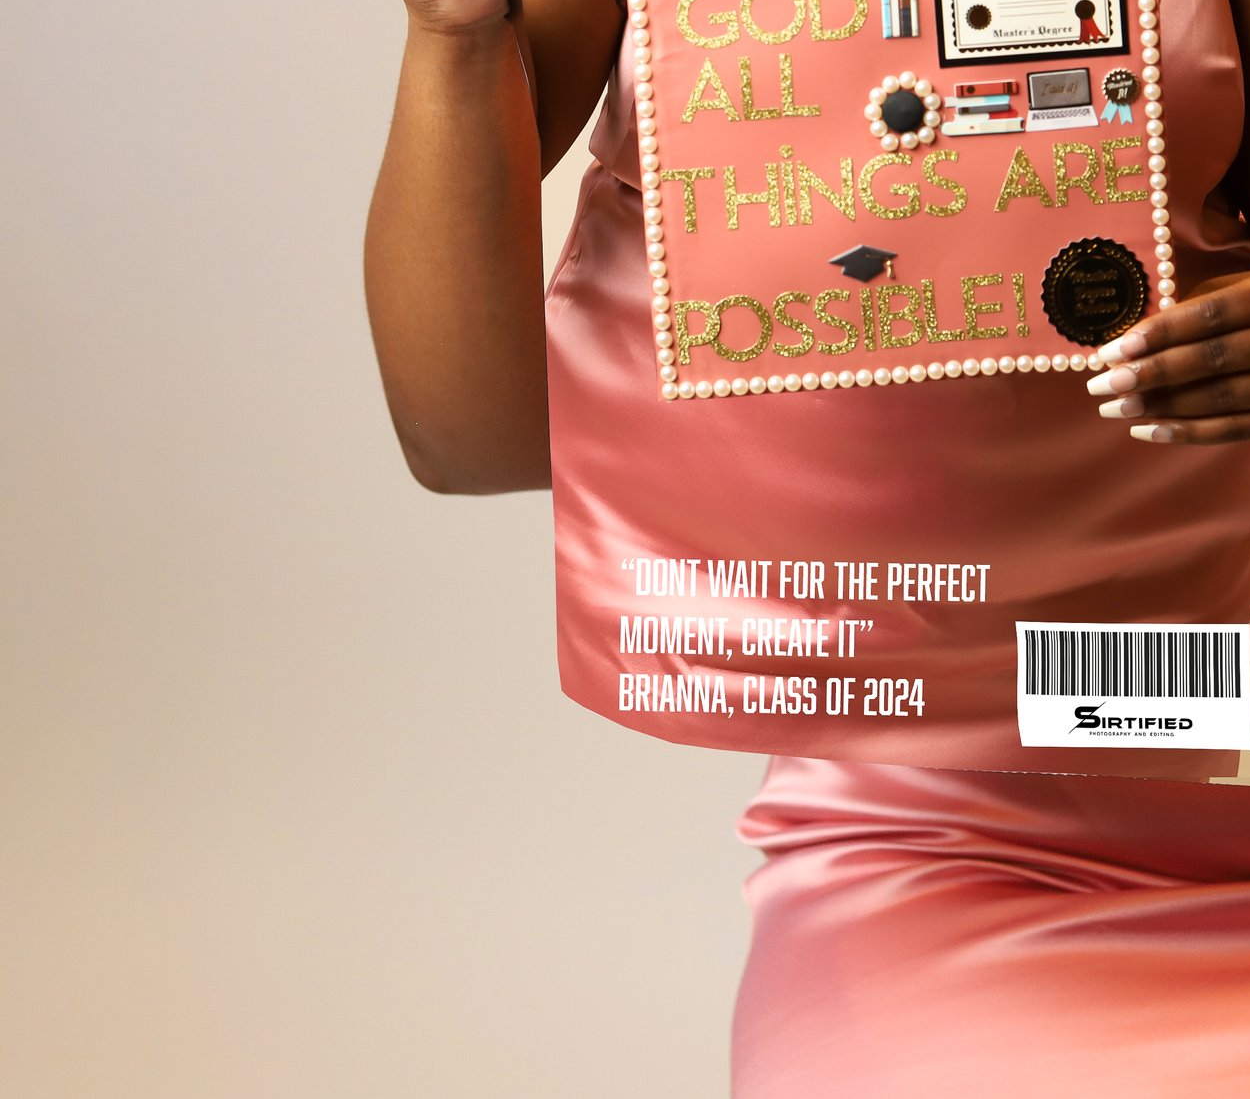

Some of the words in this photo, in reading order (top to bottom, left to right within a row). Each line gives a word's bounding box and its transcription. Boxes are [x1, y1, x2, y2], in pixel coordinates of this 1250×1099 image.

[681, 54, 822, 124] ALL
[994, 136, 1149, 213] ARE
[673, 272, 1031, 366] POSSIBLE!
[707, 560, 773, 599] WAIT
[779, 561, 826, 600] FOR
[834, 562, 879, 601] THE
[887, 564, 992, 603] PERFECT
[619, 615, 734, 661] MOMENT,
[741, 617, 831, 658] CREATE
[618, 673, 735, 719] BRIANNA,
[743, 676, 818, 716] CLASS
[825, 677, 857, 717] OF
[863, 678, 926, 717] 2024
